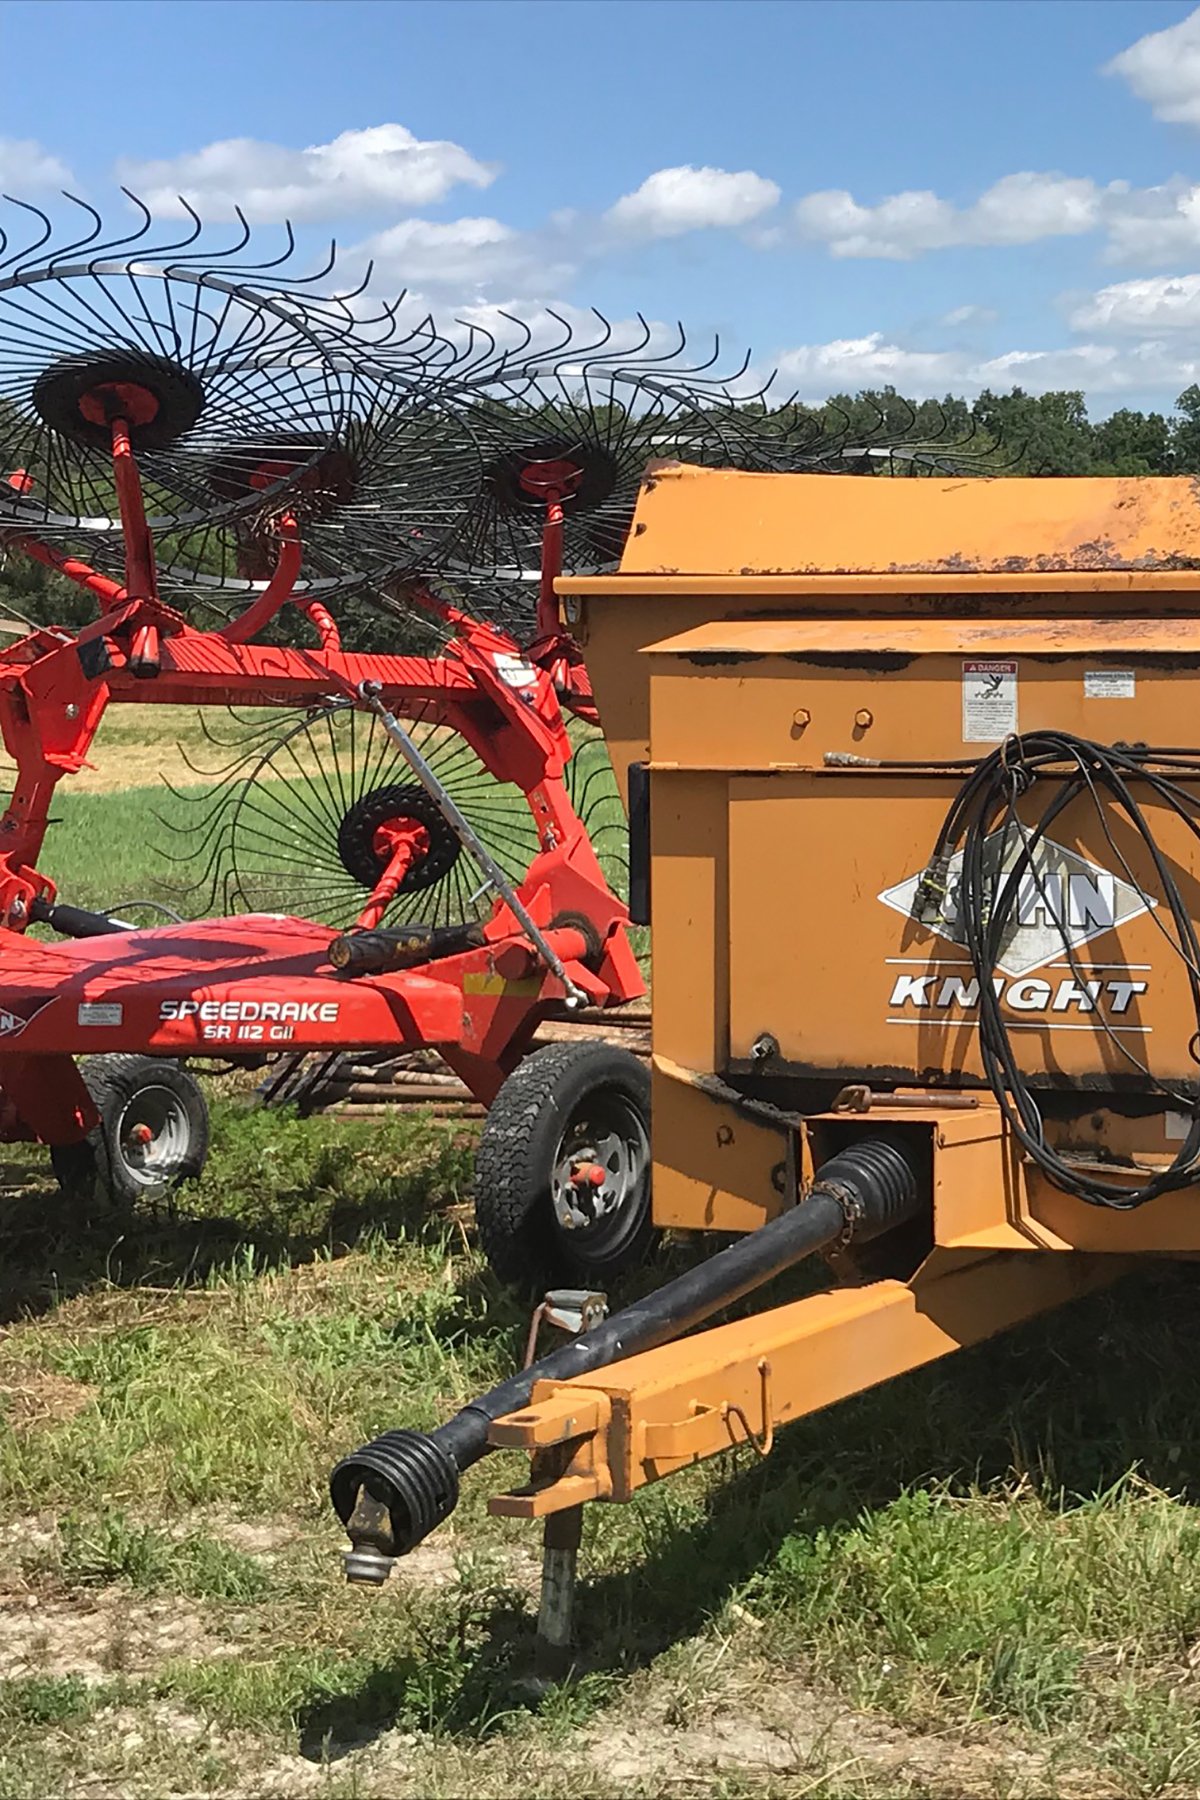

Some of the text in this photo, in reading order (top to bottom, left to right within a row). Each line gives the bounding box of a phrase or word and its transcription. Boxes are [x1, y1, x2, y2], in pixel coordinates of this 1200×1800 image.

[977, 663, 1012, 672] DANGER
[919, 873, 1115, 927] HN
[159, 1000, 339, 1022] SPEEDRAKE
[203, 1025, 231, 1039] SR
[237, 1025, 263, 1039] 112
